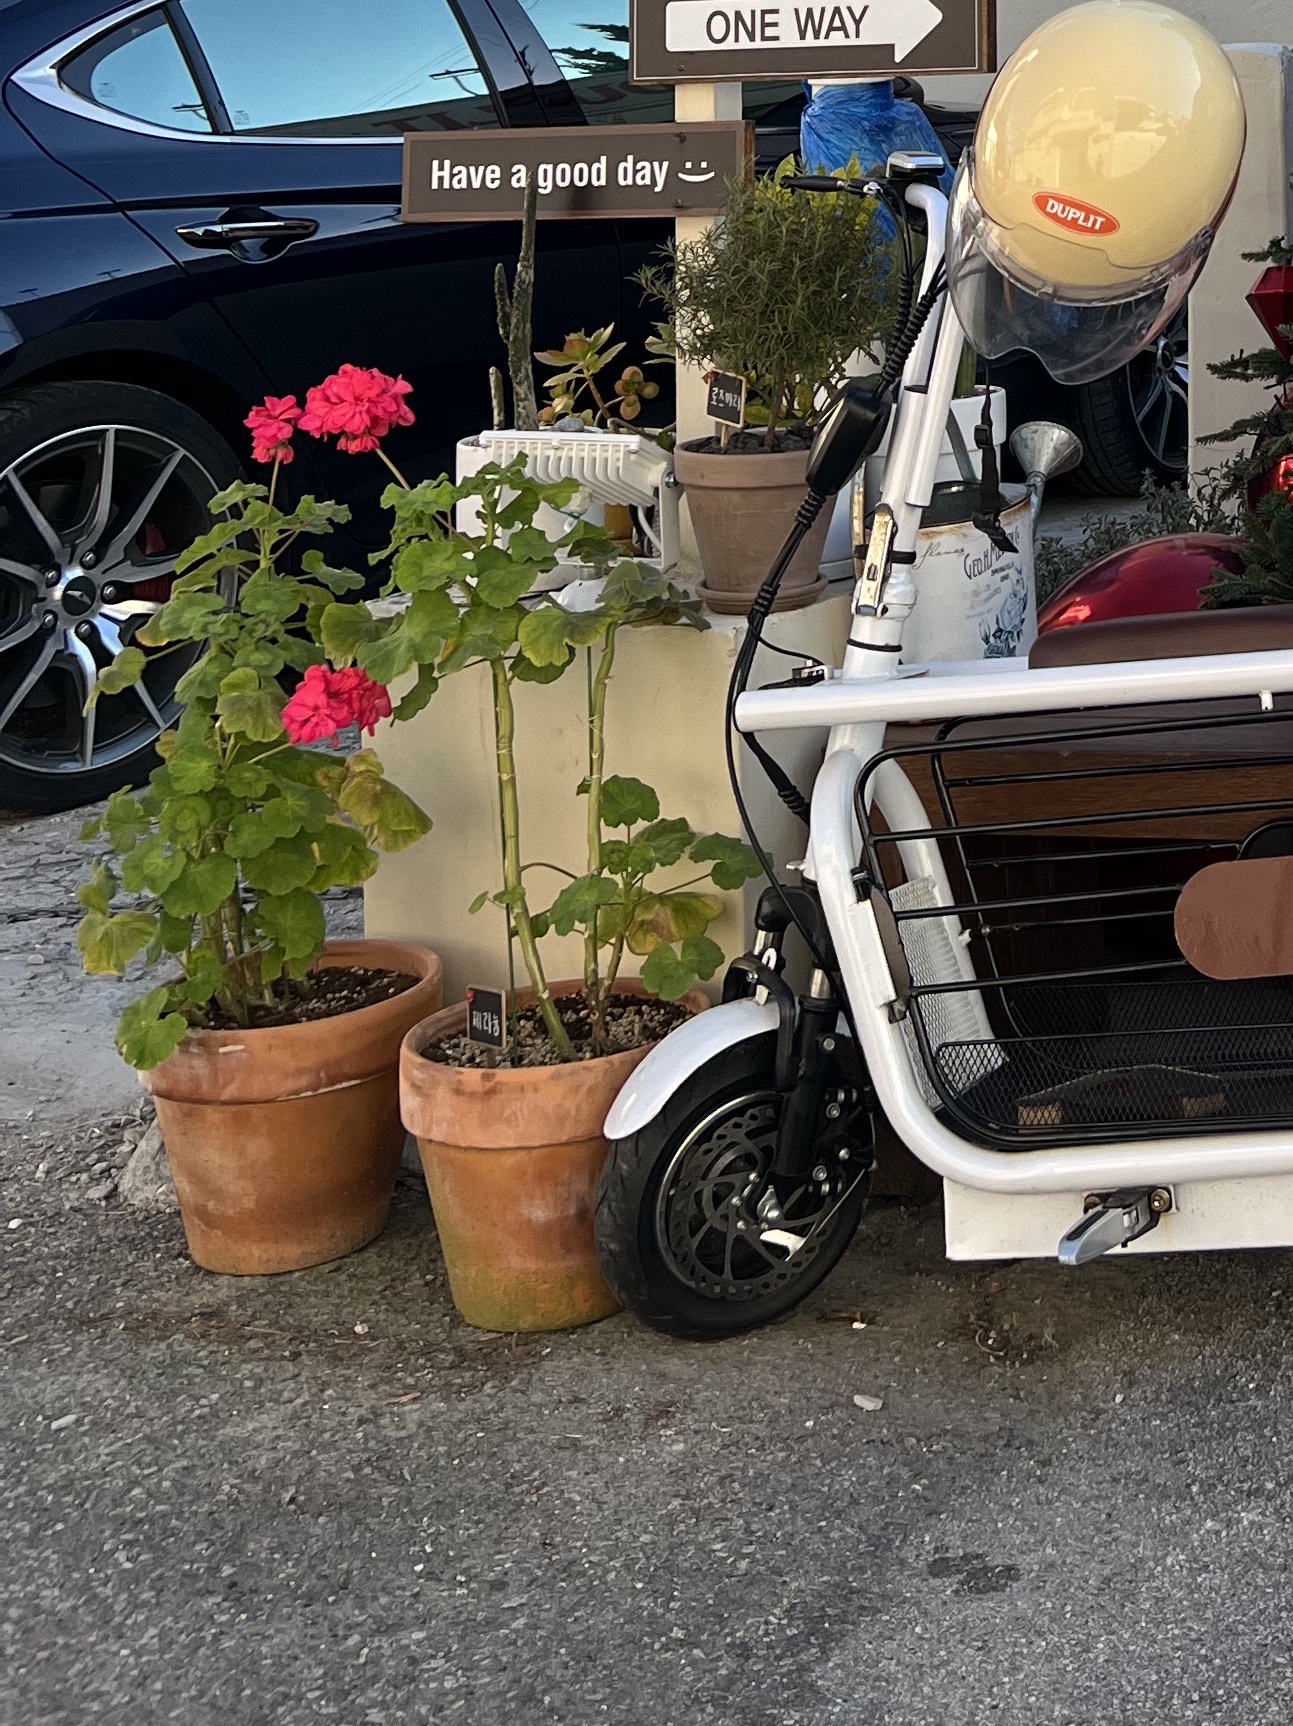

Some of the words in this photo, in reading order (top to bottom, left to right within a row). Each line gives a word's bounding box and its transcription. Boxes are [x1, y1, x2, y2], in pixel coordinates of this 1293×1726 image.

[706, 8, 780, 44] ONE
[793, 4, 870, 40] WAY
[431, 159, 501, 190] Have
[510, 163, 528, 189] a
[537, 155, 607, 195] good
[617, 154, 670, 193] day
[1045, 197, 1107, 231] DUPLIT
